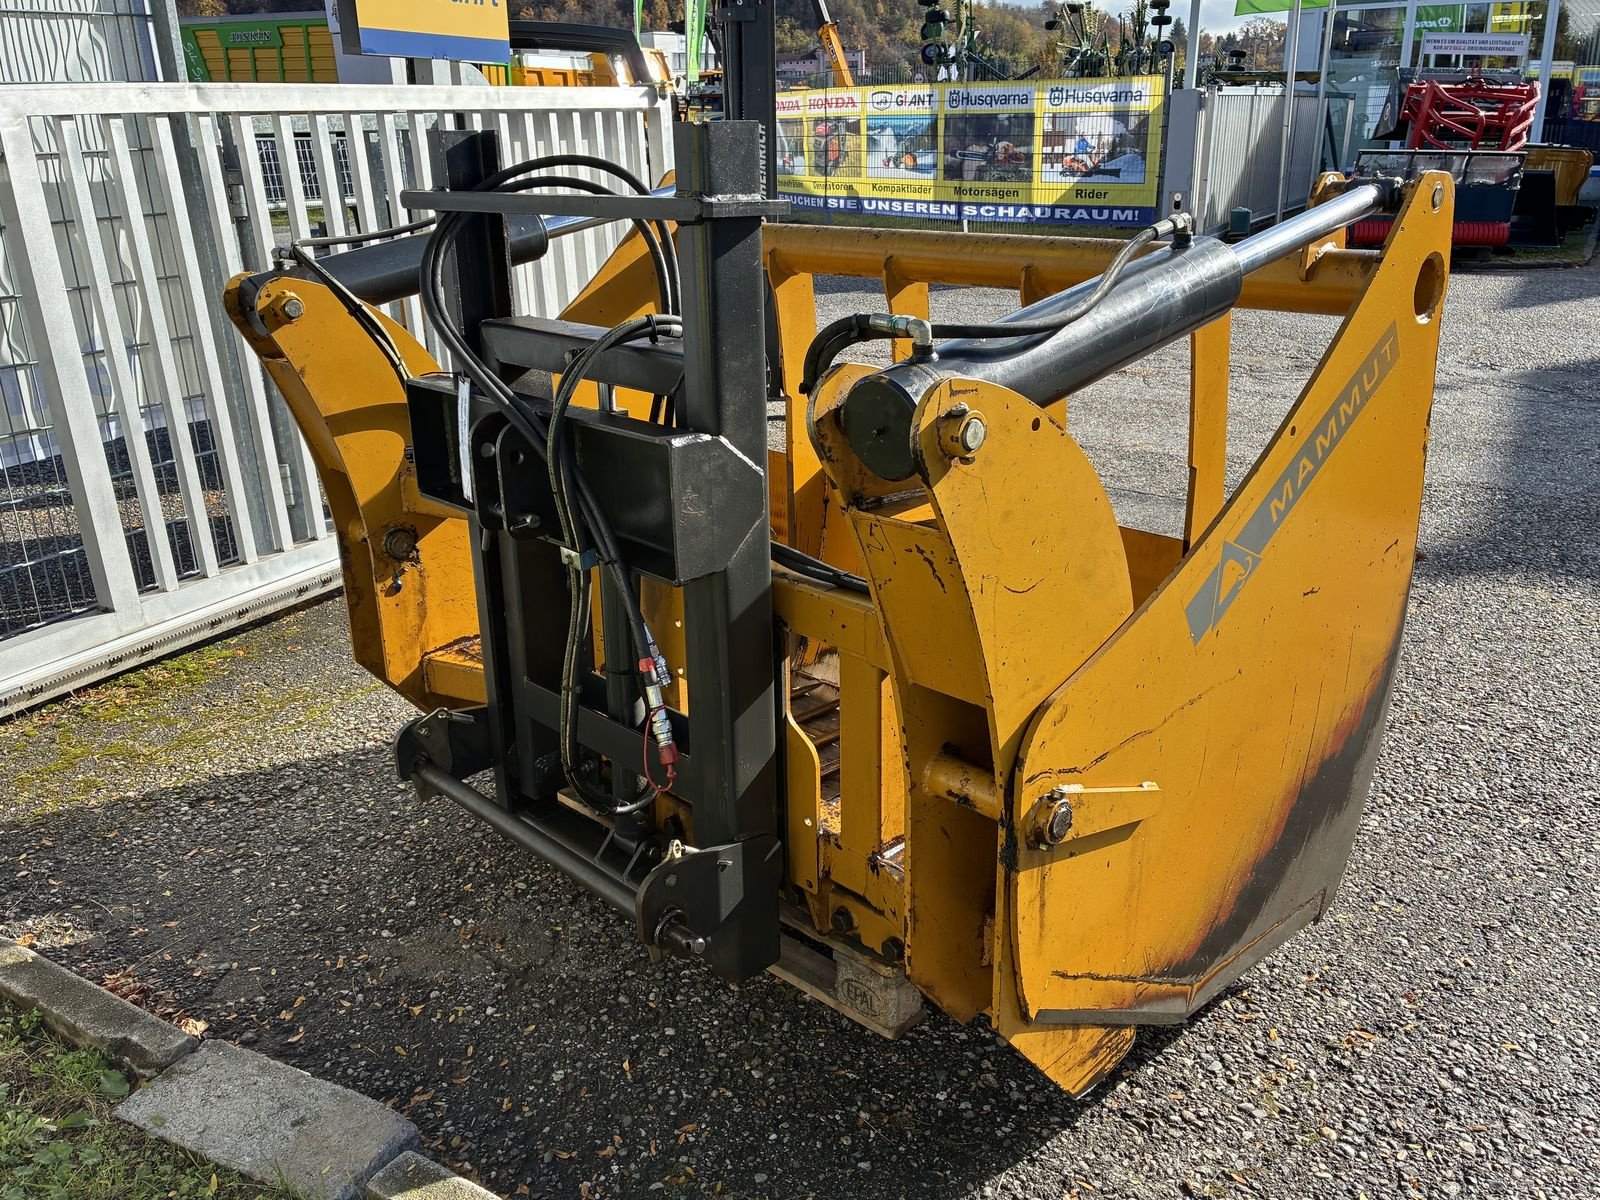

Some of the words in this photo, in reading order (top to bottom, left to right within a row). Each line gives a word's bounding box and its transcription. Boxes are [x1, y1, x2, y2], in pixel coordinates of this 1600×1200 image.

[961, 91, 1029, 107] Husqvarna
[1065, 87, 1143, 104] Husqvarna
[776, 100, 801, 112] ONDA
[808, 96, 858, 110] HONDA
[813, 181, 854, 191] Generatoren
[872, 182, 932, 195] Kompaktlader
[953, 186, 1019, 198] Motorsägen
[1075, 188, 1109, 200] Rider
[779, 194, 824, 208] ESUCHEN
[827, 198, 857, 209] SIE
[863, 200, 957, 215] UNSEREN
[963, 205, 1139, 222] SCHAURAUM!
[1269, 335, 1395, 524] MAMMUT
